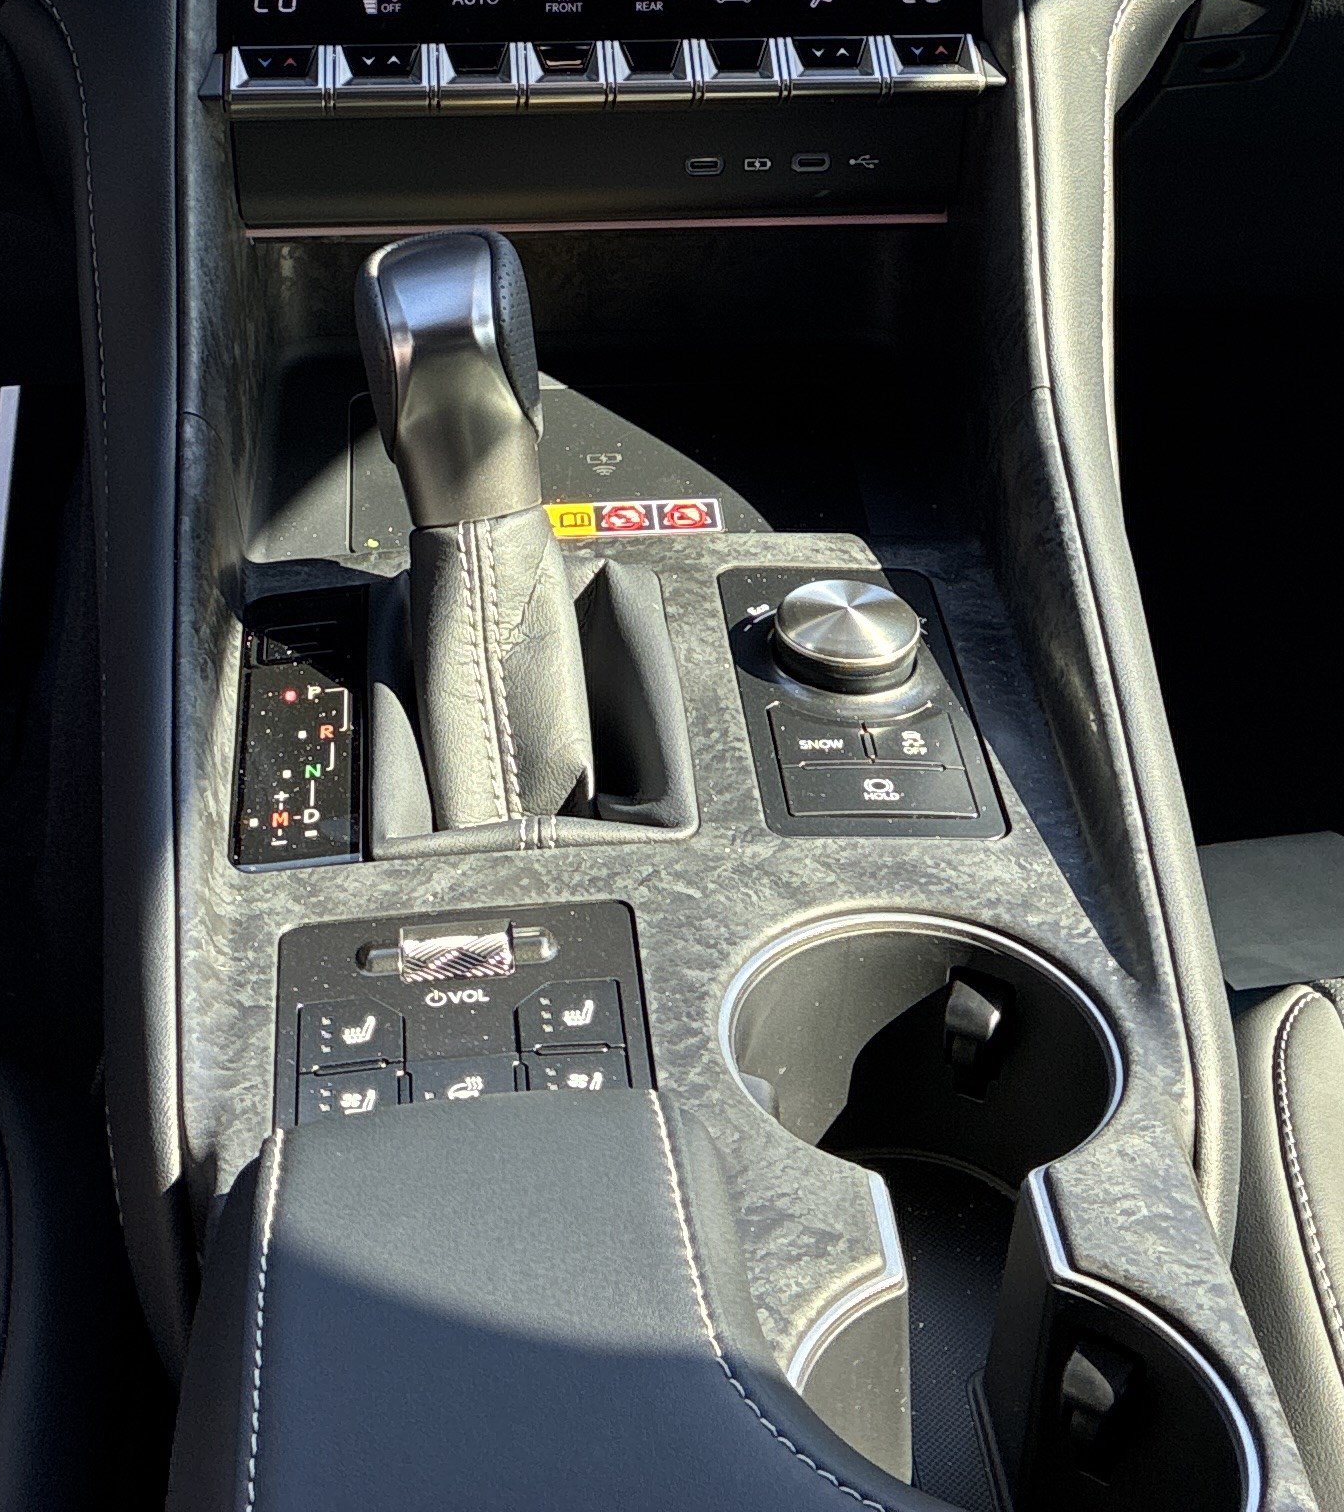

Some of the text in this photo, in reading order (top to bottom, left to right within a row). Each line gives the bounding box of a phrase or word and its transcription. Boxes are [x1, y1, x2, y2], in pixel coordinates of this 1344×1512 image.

[380, 3, 402, 13] OFF
[545, 2, 583, 13] FRONT
[635, 1, 664, 12] REAR
[307, 686, 322, 700] P
[319, 724, 335, 739] R
[798, 739, 844, 750] SNOW
[304, 764, 321, 778] N
[863, 791, 901, 801] HOLD
[271, 808, 320, 827] M D
[449, 989, 490, 1004] VOL
